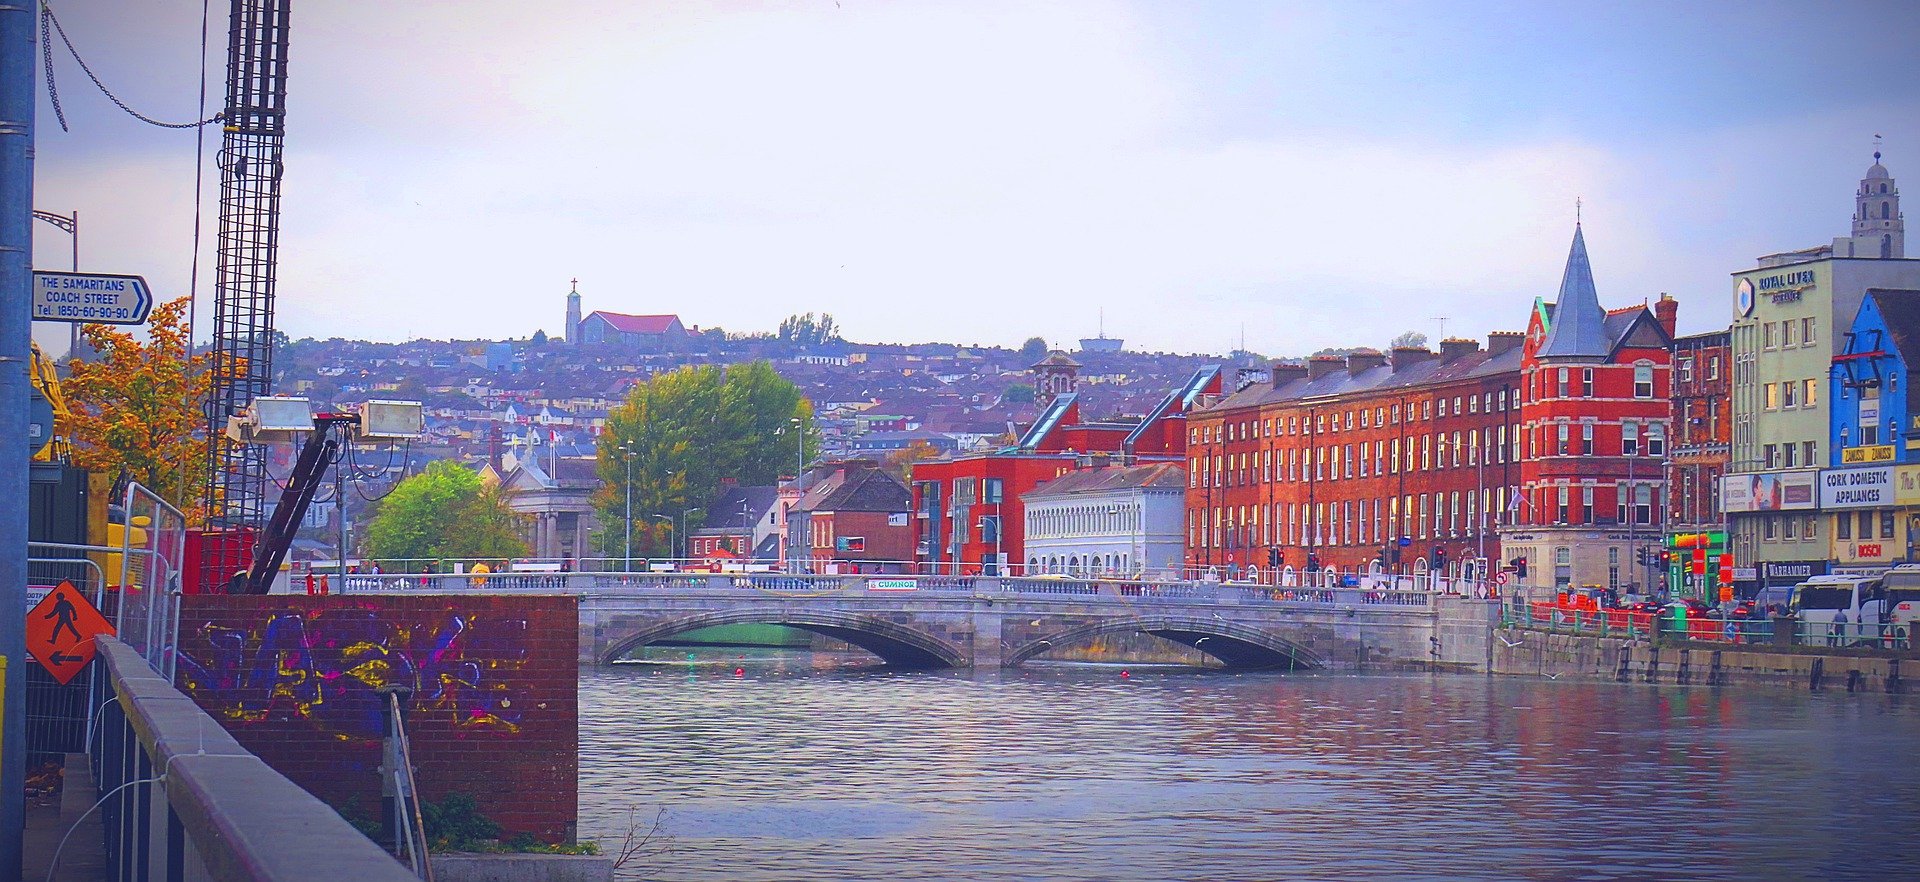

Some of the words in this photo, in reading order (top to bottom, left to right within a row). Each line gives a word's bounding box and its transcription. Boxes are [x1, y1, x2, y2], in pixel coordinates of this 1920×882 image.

[41, 277, 58, 288] THE
[63, 279, 124, 291] SAMARITANS
[1760, 275, 1785, 290] ROYAL
[1788, 270, 1814, 285] LIVER
[46, 291, 80, 303] COACH
[85, 293, 119, 304] STREET
[58, 305, 129, 319] 1850-60-90-90
[1872, 447, 1892, 460] ZANUSSI
[1827, 473, 1847, 487] CORK
[1850, 471, 1887, 486] DOMESTIC
[1835, 489, 1880, 503] APPLIANCES
[1858, 544, 1881, 557] BOSCH
[1768, 564, 1811, 577] WARHAMMER
